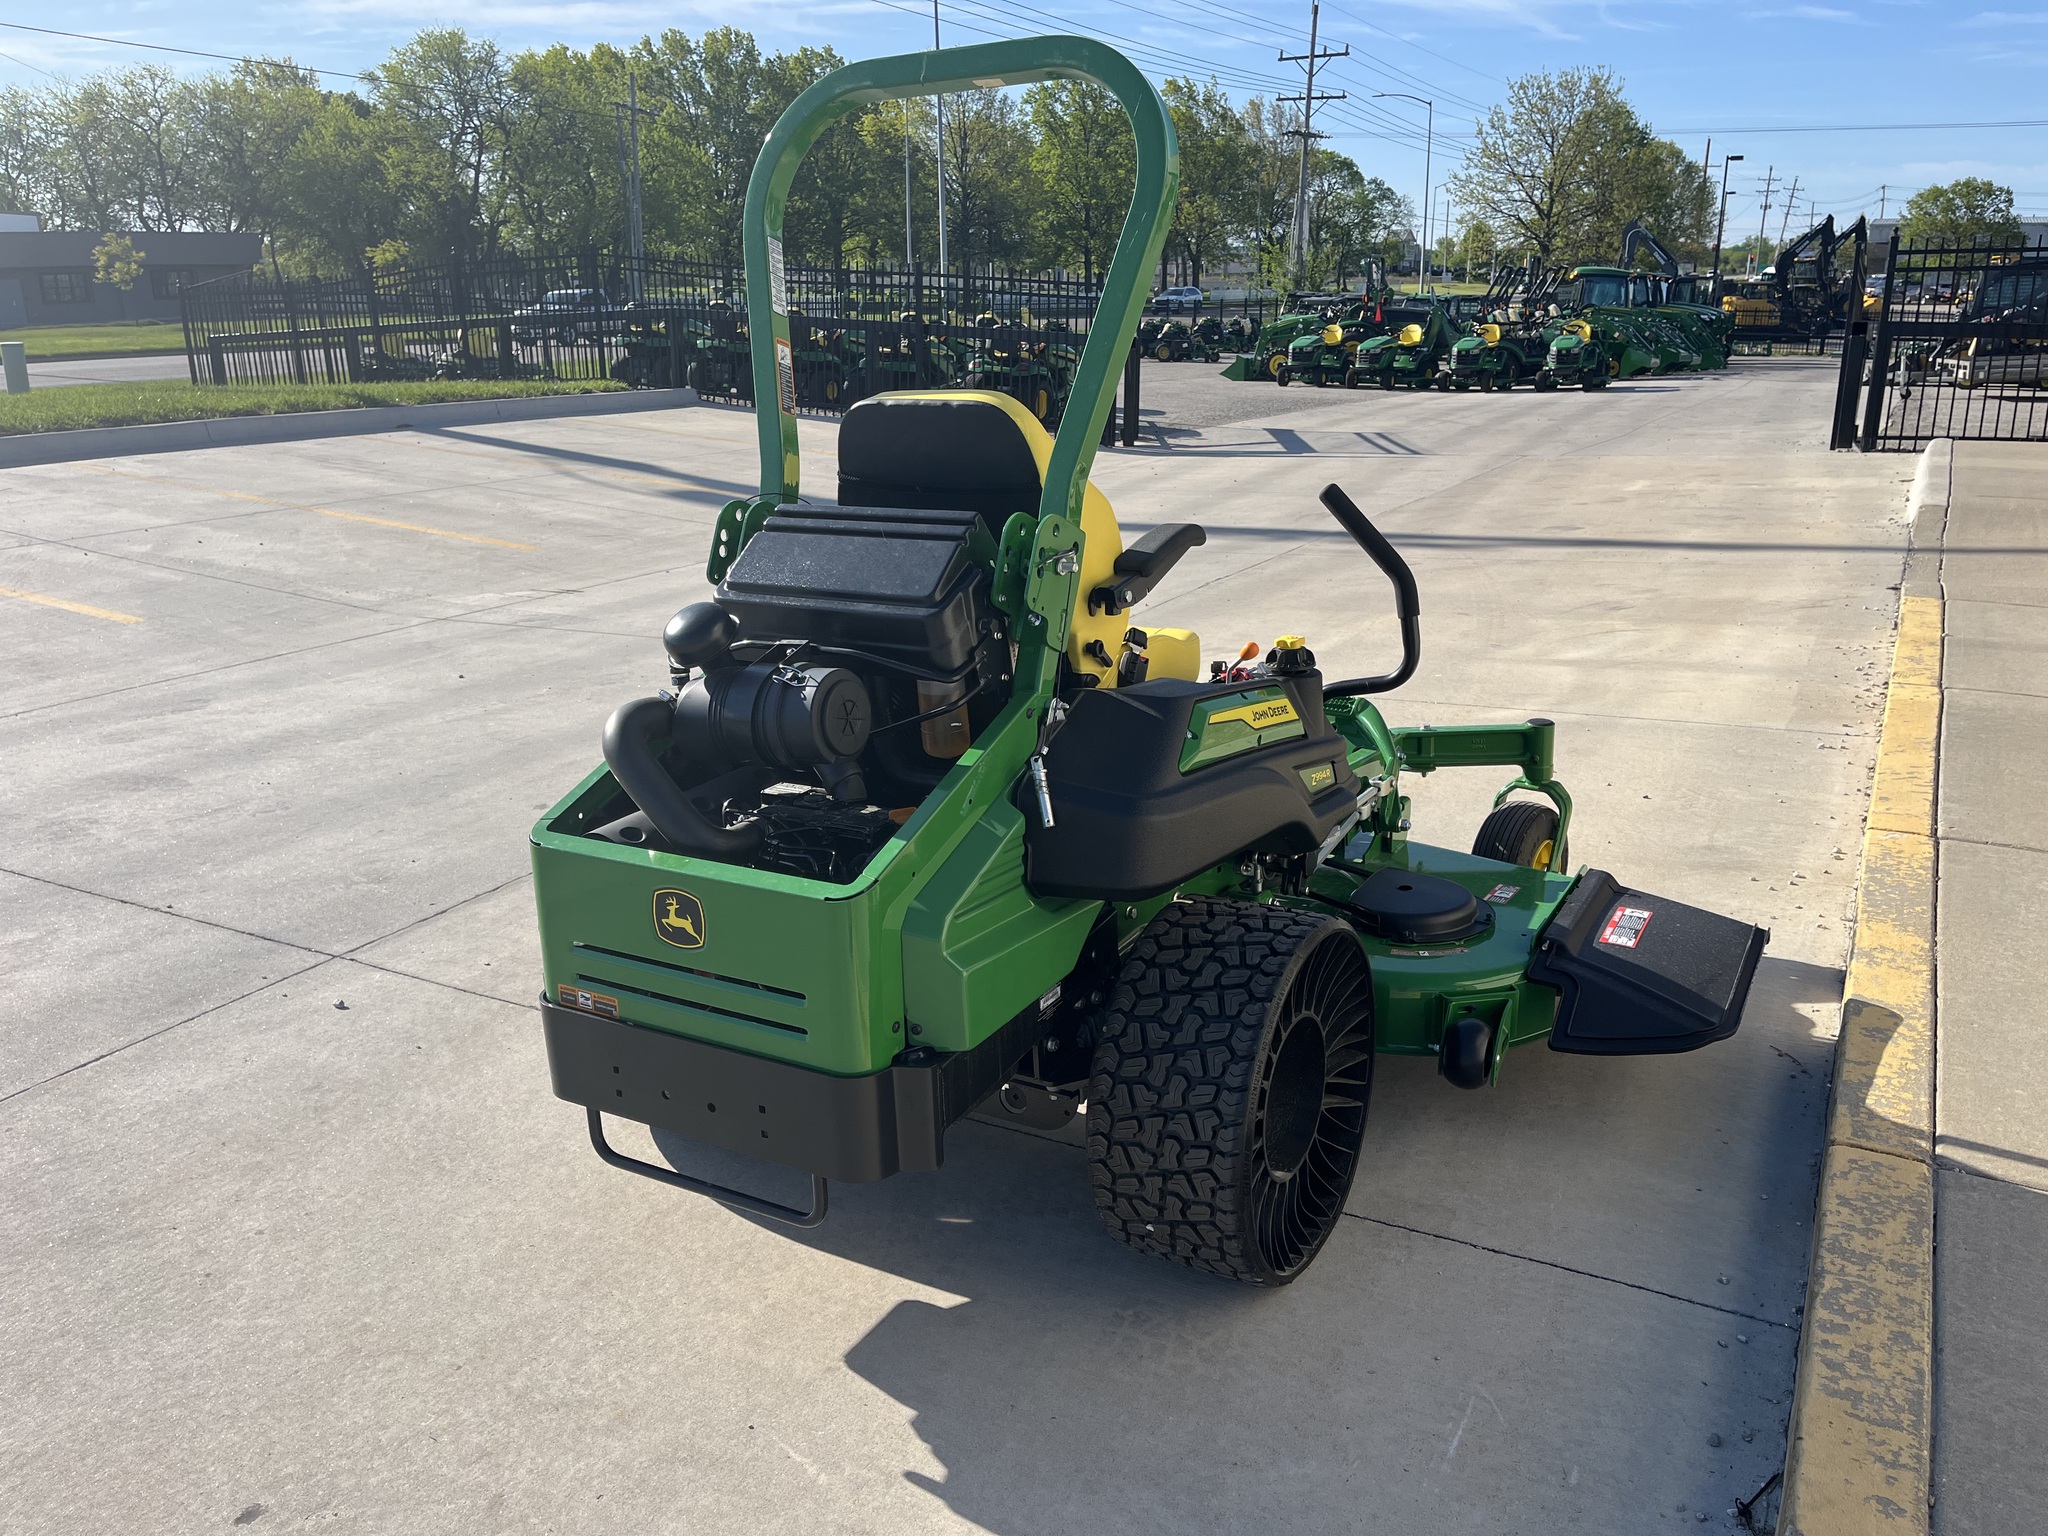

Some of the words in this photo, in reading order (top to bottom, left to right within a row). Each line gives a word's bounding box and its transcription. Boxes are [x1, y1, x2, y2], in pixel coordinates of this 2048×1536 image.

[1252, 710, 1269, 722] JOHN
[1268, 705, 1289, 718] DEERE
[1311, 769, 1330, 786] Z994R
[1266, 1020, 1274, 1035] FOR
[1272, 987, 1286, 1017] HIGHWAY
[1284, 974, 1292, 986] USE
